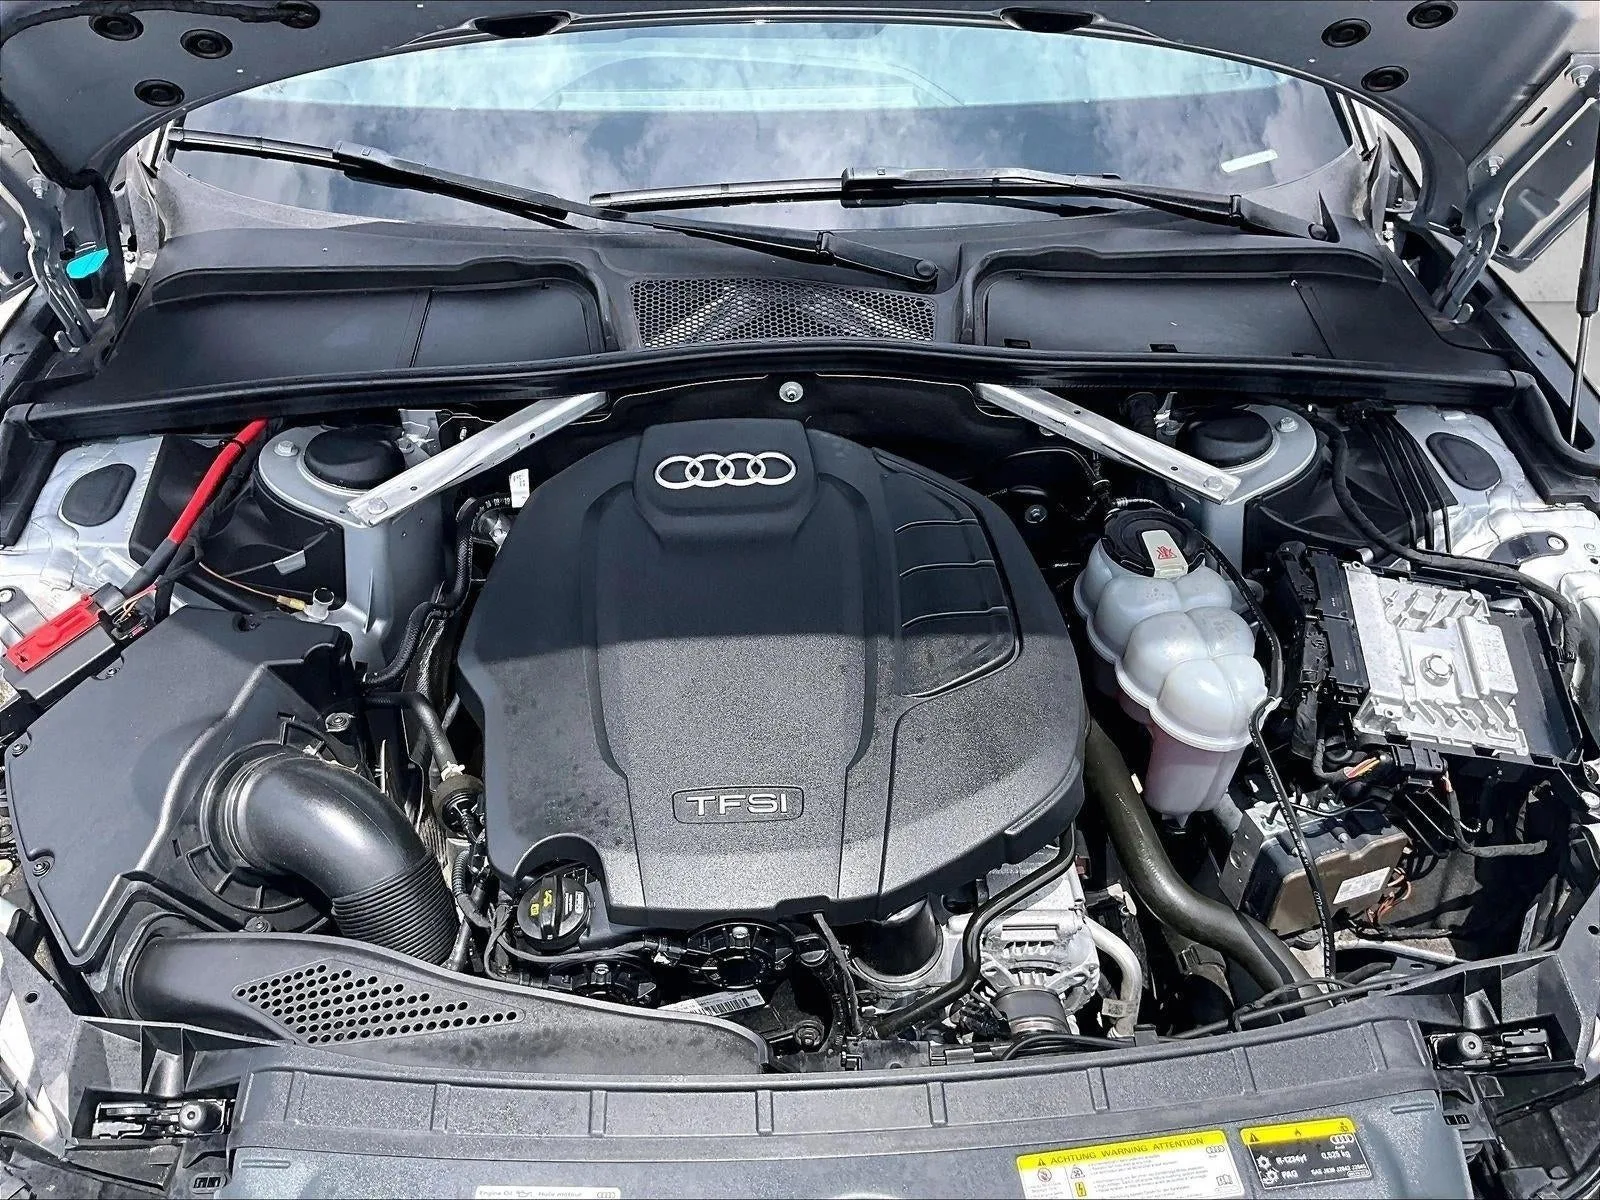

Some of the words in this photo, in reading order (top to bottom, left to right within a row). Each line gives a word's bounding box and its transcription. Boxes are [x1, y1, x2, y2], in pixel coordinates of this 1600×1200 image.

[686, 793, 788, 816] TFSI
[1050, 1152, 1097, 1165] ACHTUNG
[1101, 1144, 1148, 1158] WARNING
[1153, 1137, 1204, 1151] ATTENTION
[1281, 1169, 1299, 1180] PAG
